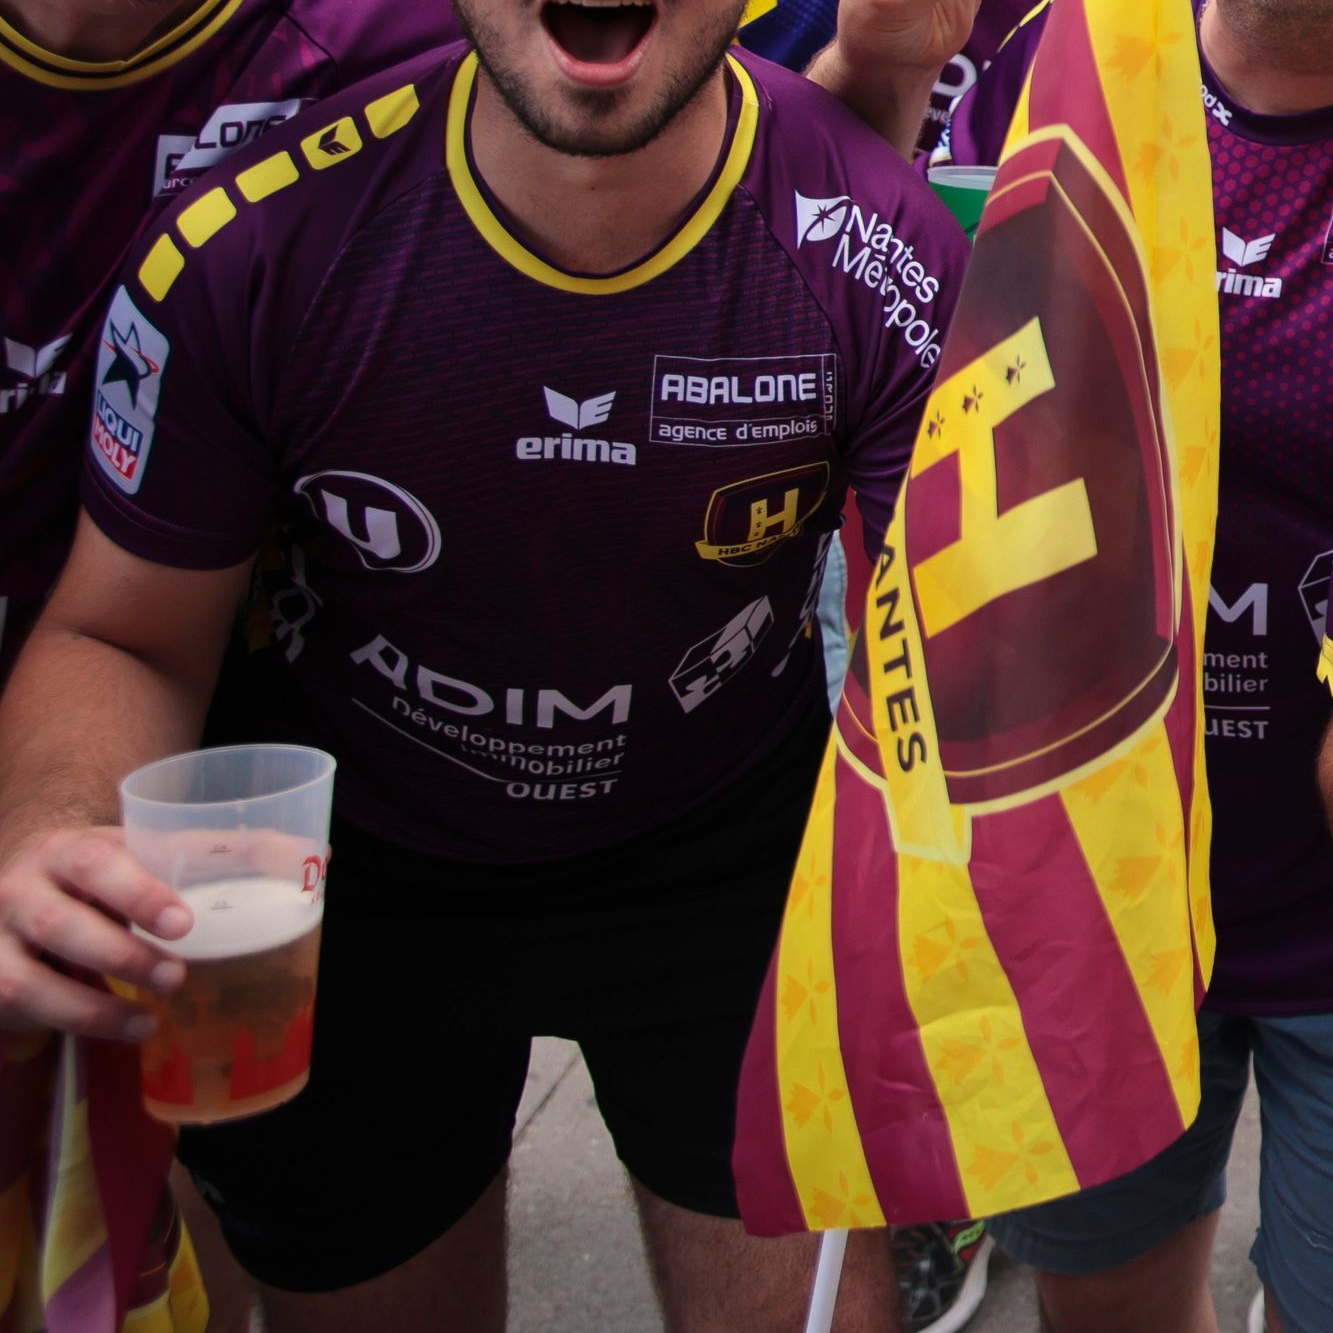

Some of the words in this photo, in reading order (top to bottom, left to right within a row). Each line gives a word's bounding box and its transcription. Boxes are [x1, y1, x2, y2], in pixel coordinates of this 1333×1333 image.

[850, 205, 940, 304] Nantes
[1217, 269, 1282, 299] rima
[661, 372, 817, 404] ABALONE
[95, 416, 137, 473] MOLY
[658, 422, 727, 441] agence
[736, 418, 818, 440] d'emplois
[516, 434, 636, 465] erima
[717, 544, 752, 557] HBC
[877, 546, 928, 774] ANTES
[350, 634, 633, 729] ADIM
[1204, 673, 1269, 694] bilier
[392, 696, 628, 757] Développement
[1204, 719, 1269, 739] UEST
[506, 779, 619, 800] OUEST
